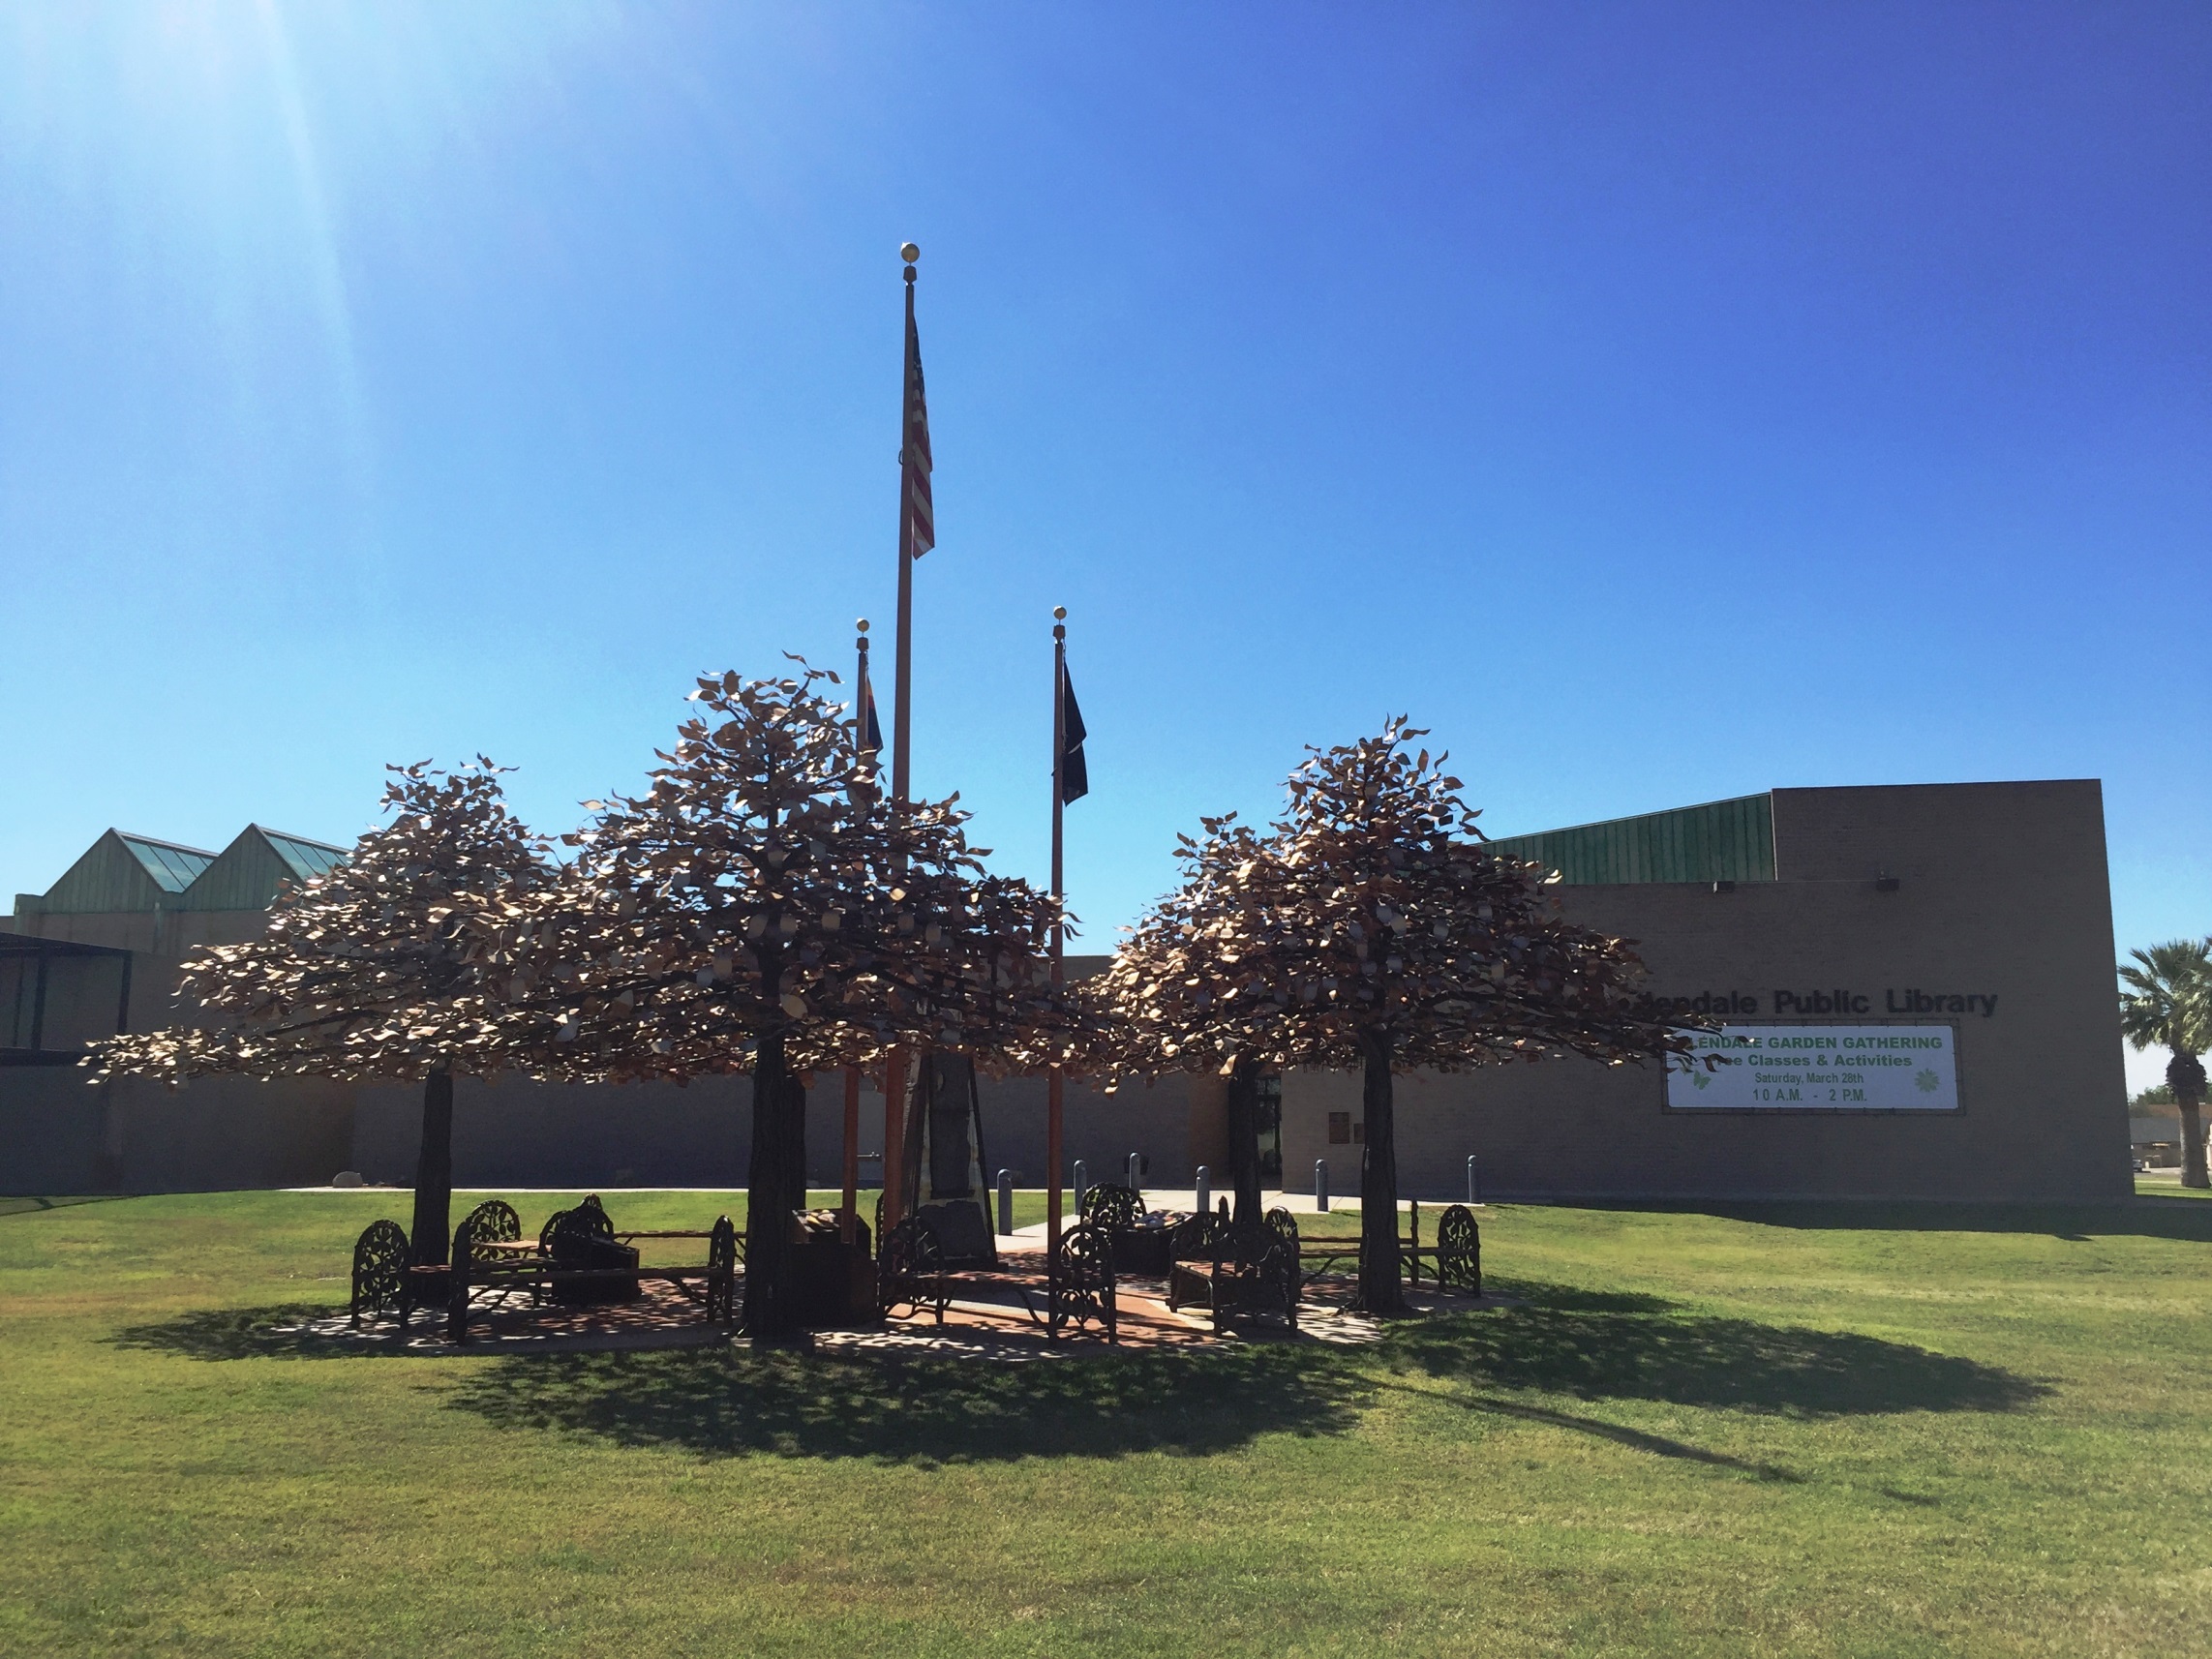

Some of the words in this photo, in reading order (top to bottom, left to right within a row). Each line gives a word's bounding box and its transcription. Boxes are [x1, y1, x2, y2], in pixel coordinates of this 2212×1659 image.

[1638, 990, 1758, 1014] lendale
[1774, 989, 1871, 1014] Public
[1886, 988, 1998, 1017] Library
[1689, 1037, 1763, 1049] ENDALE
[1768, 1037, 1837, 1049] GARDEN
[1842, 1037, 1943, 1049] GATHERING
[1747, 1054, 1811, 1066] Classes
[1816, 1054, 1829, 1066] &
[1834, 1054, 1913, 1066] Activities
[1754, 1072, 1804, 1085] Saturday,
[1806, 1072, 1838, 1084] March
[1841, 1072, 1864, 1084] 28th
[1775, 1089, 1803, 1101] A.M.
[1829, 1089, 1836, 1101] 2
[1843, 1089, 1867, 1101] P.M.
